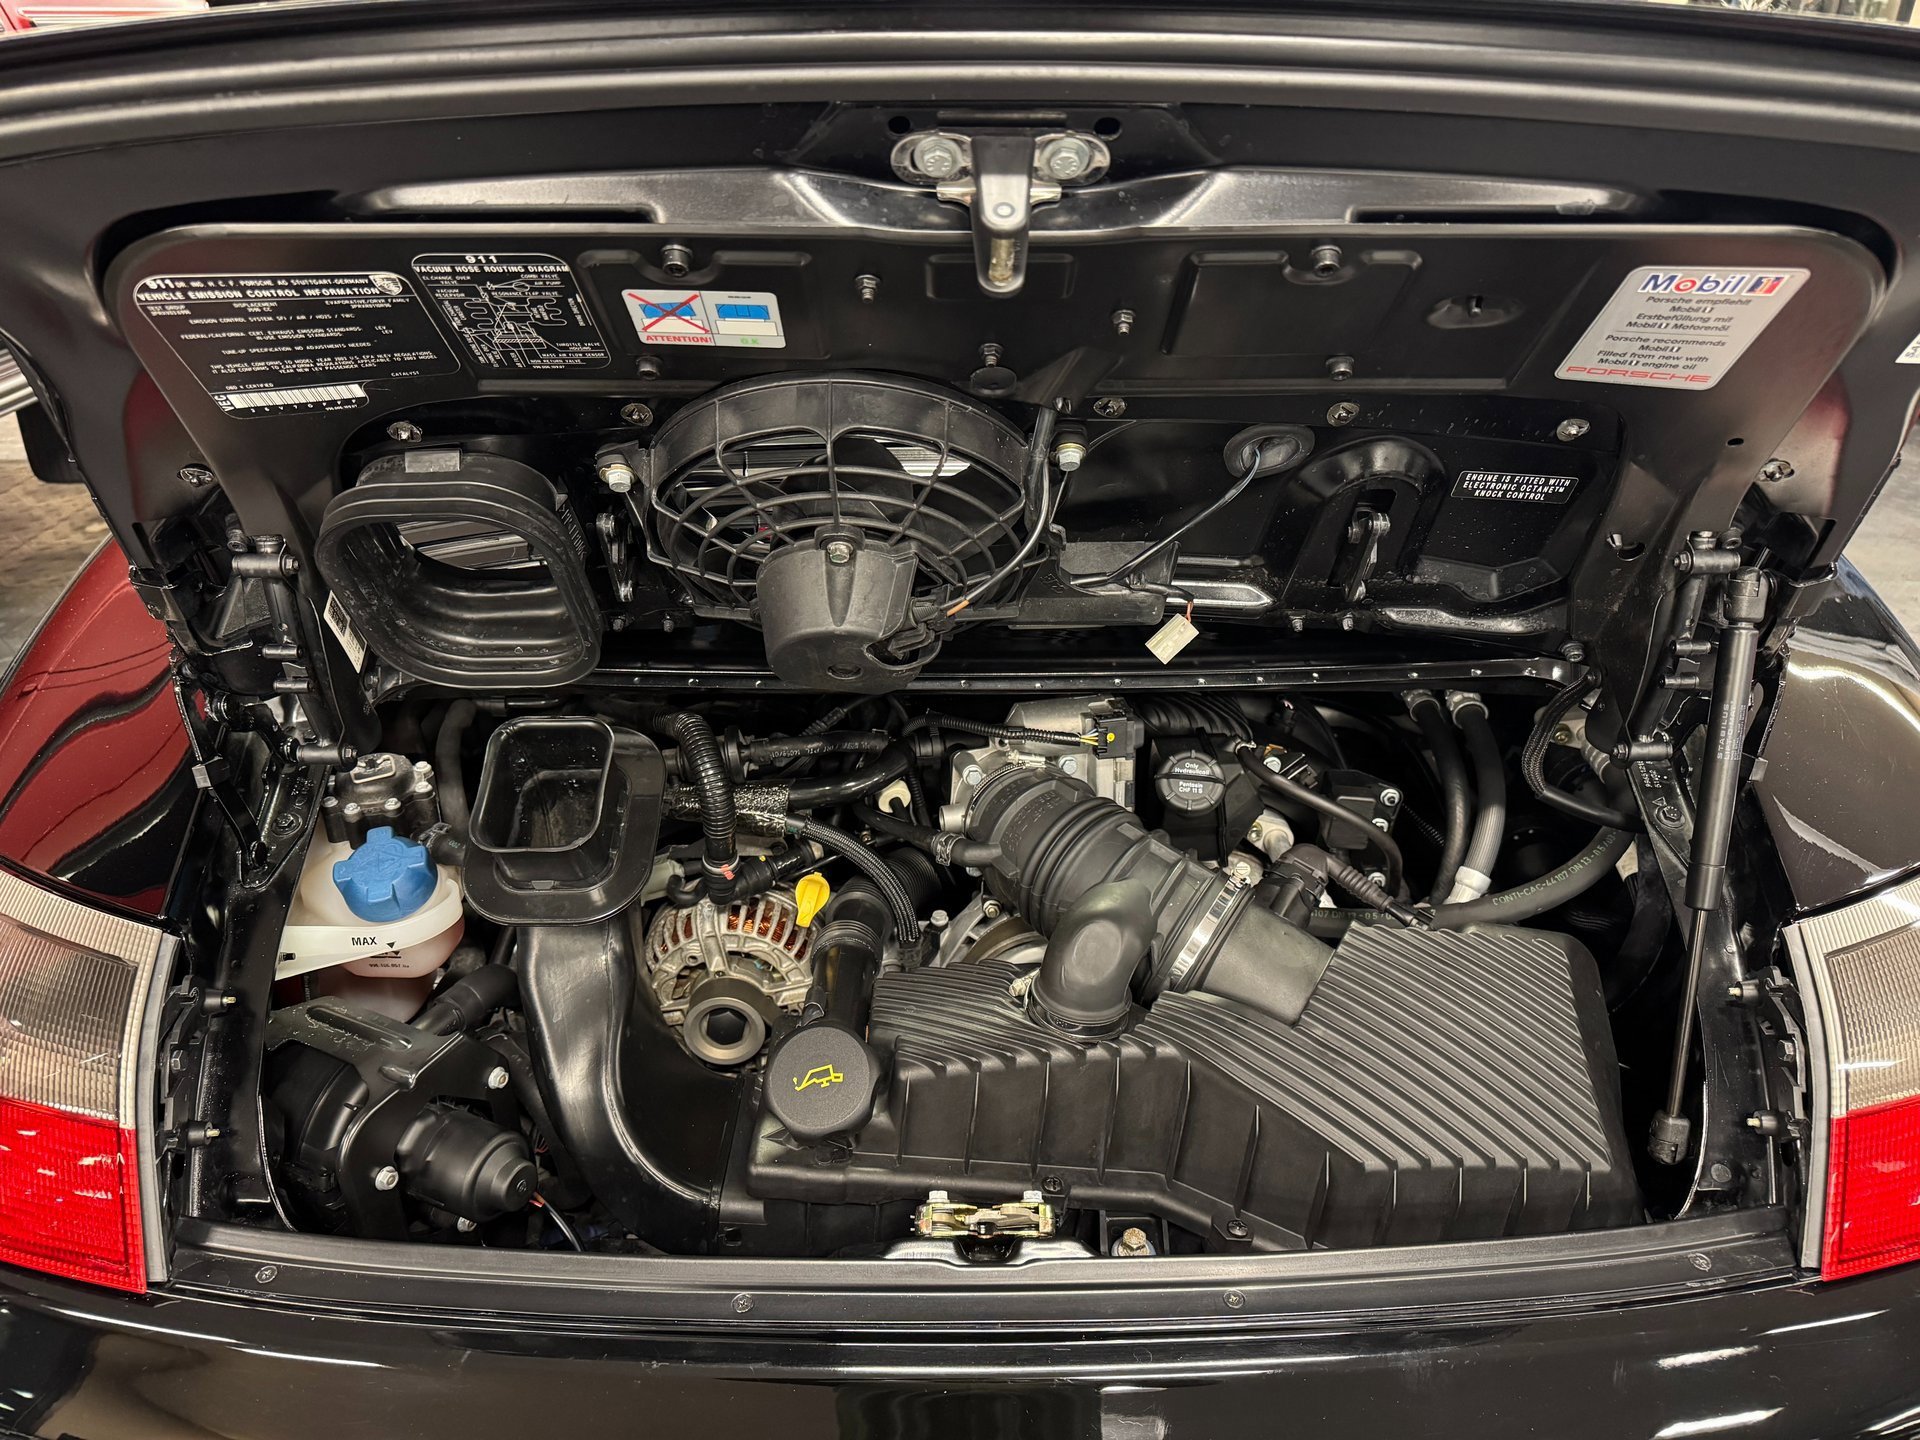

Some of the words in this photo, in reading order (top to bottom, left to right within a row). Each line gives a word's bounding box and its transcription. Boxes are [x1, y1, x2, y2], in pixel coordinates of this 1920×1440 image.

[465, 255, 497, 264] 911
[146, 279, 175, 289] 911
[1639, 274, 1746, 293] Mobil
[137, 291, 185, 301] VEHICLE
[188, 290, 242, 299] EMISSION
[246, 289, 300, 298] CONTROL
[304, 288, 380, 296] INFORMATION
[1646, 296, 1694, 304] Porsche
[1695, 298, 1752, 306] empfiehlt
[1636, 313, 1711, 323] Erstbefüllung
[1671, 323, 1730, 331] Motorenöl
[646, 335, 712, 343] ATTENTION!
[1606, 335, 1650, 343] Porsche
[1653, 337, 1727, 346] recommends
[1642, 361, 1679, 369] engine
[1566, 366, 1712, 383] PORSCHE
[1466, 474, 1498, 482] ENGINE
[1514, 476, 1546, 485] FITTED
[1548, 479, 1571, 487] WITH
[1463, 481, 1517, 491] ELECTRONIC
[1474, 490, 1504, 498] KNOCK
[1506, 492, 1545, 501] CONTROL
[351, 936, 378, 946] MAX
